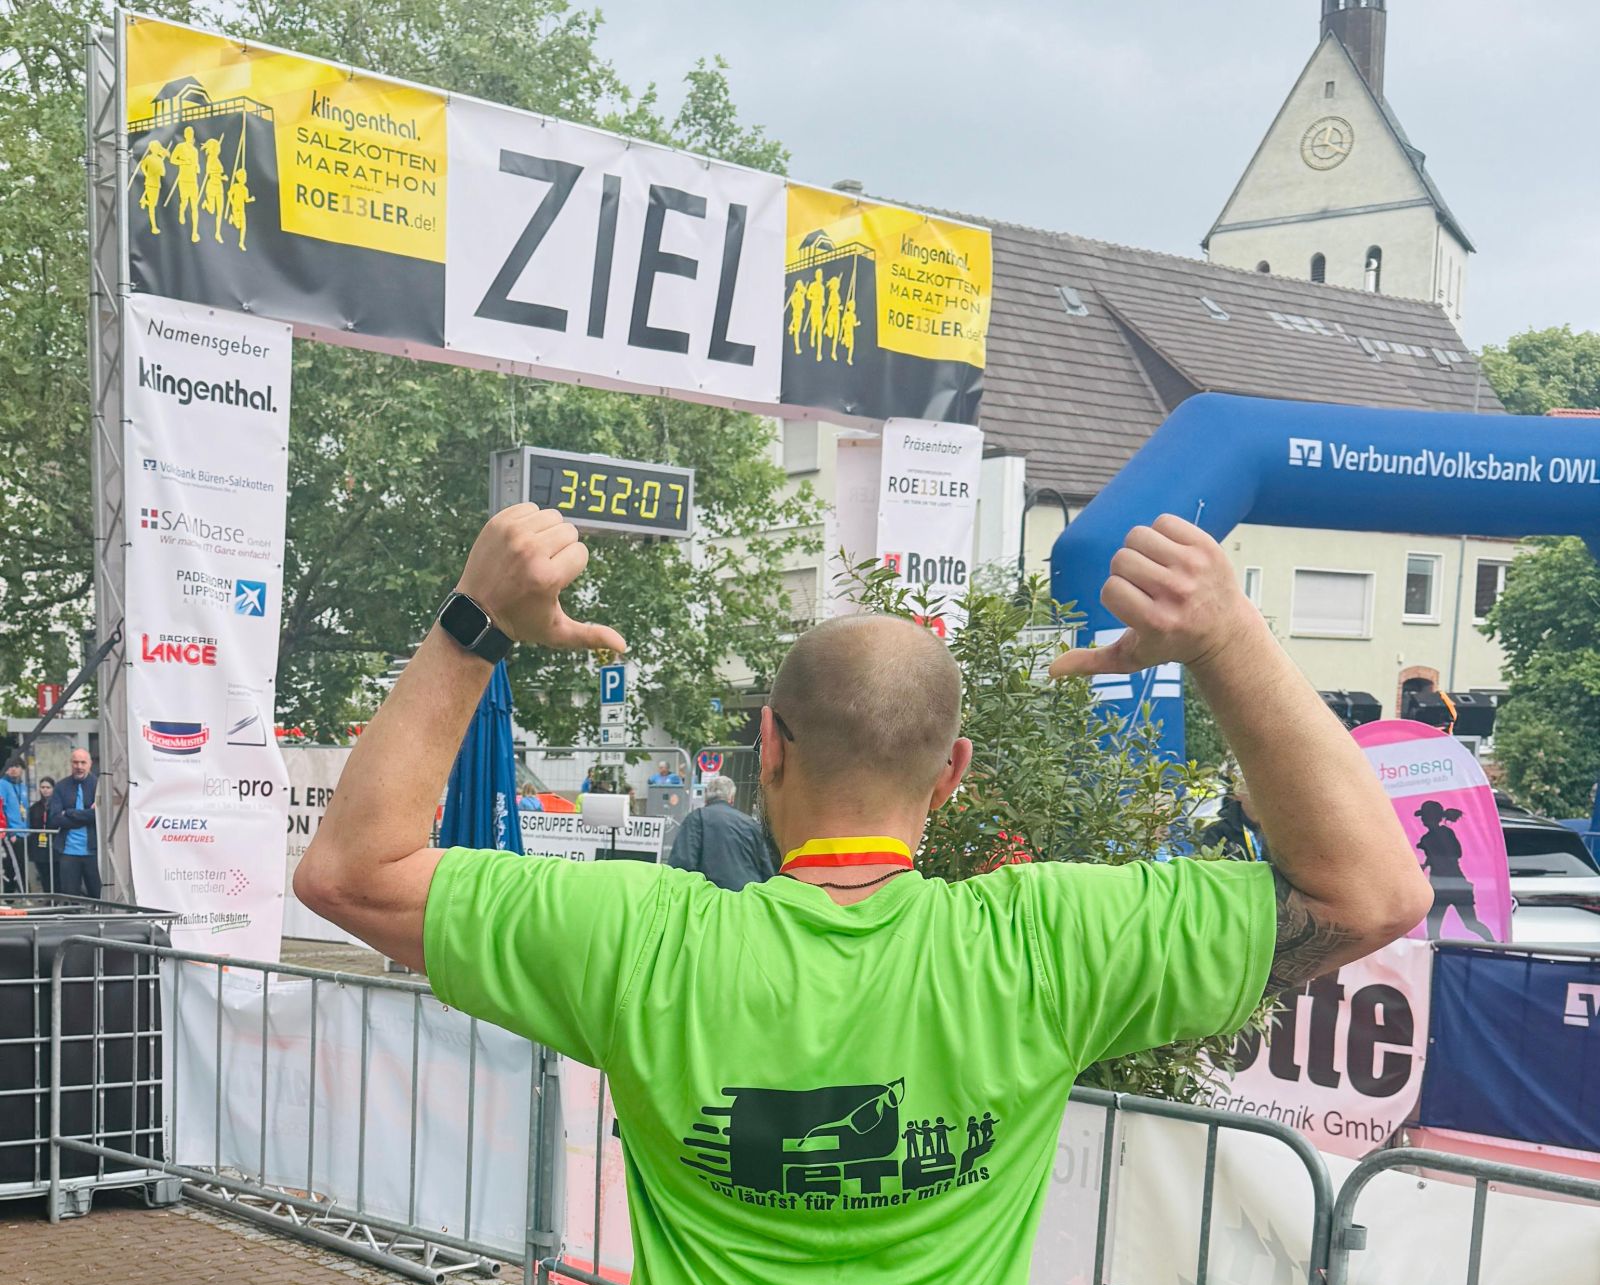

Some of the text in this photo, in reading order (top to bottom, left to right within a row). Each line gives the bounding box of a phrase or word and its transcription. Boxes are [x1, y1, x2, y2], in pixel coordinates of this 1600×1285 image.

[311, 89, 421, 142] klingenthal.
[296, 126, 436, 174] SALZKOTTEN
[296, 150, 436, 196] MARATHON
[296, 183, 436, 233] ROE13LER.de!
[473, 148, 756, 366] ZIEL
[891, 263, 981, 297] SALZKOTTEN
[889, 283, 981, 314] MARATHON
[147, 318, 270, 358] Namensgeber
[139, 356, 277, 413] klingenthal.
[903, 434, 963, 454] Präsentator
[198, 470, 274, 492] Büren-Salzkotten
[1329, 443, 1600, 485] VerbundVolksbank OWL
[557, 469, 685, 521] 3:52:07
[888, 476, 970, 499] ROE13LER
[907, 552, 966, 586] Rotte
[606, 671, 620, 700] P
[202, 772, 273, 802] lean-pro
[161, 818, 208, 831] CEMEX
[161, 834, 215, 844] ADMIXTURES
[624, 820, 661, 839] GMBH
[164, 868, 227, 882] lichtenstein
[190, 882, 225, 895] medien
[1204, 969, 1415, 1098] tte
[710, 1165, 990, 1211] Du läufst für immer mit uns
